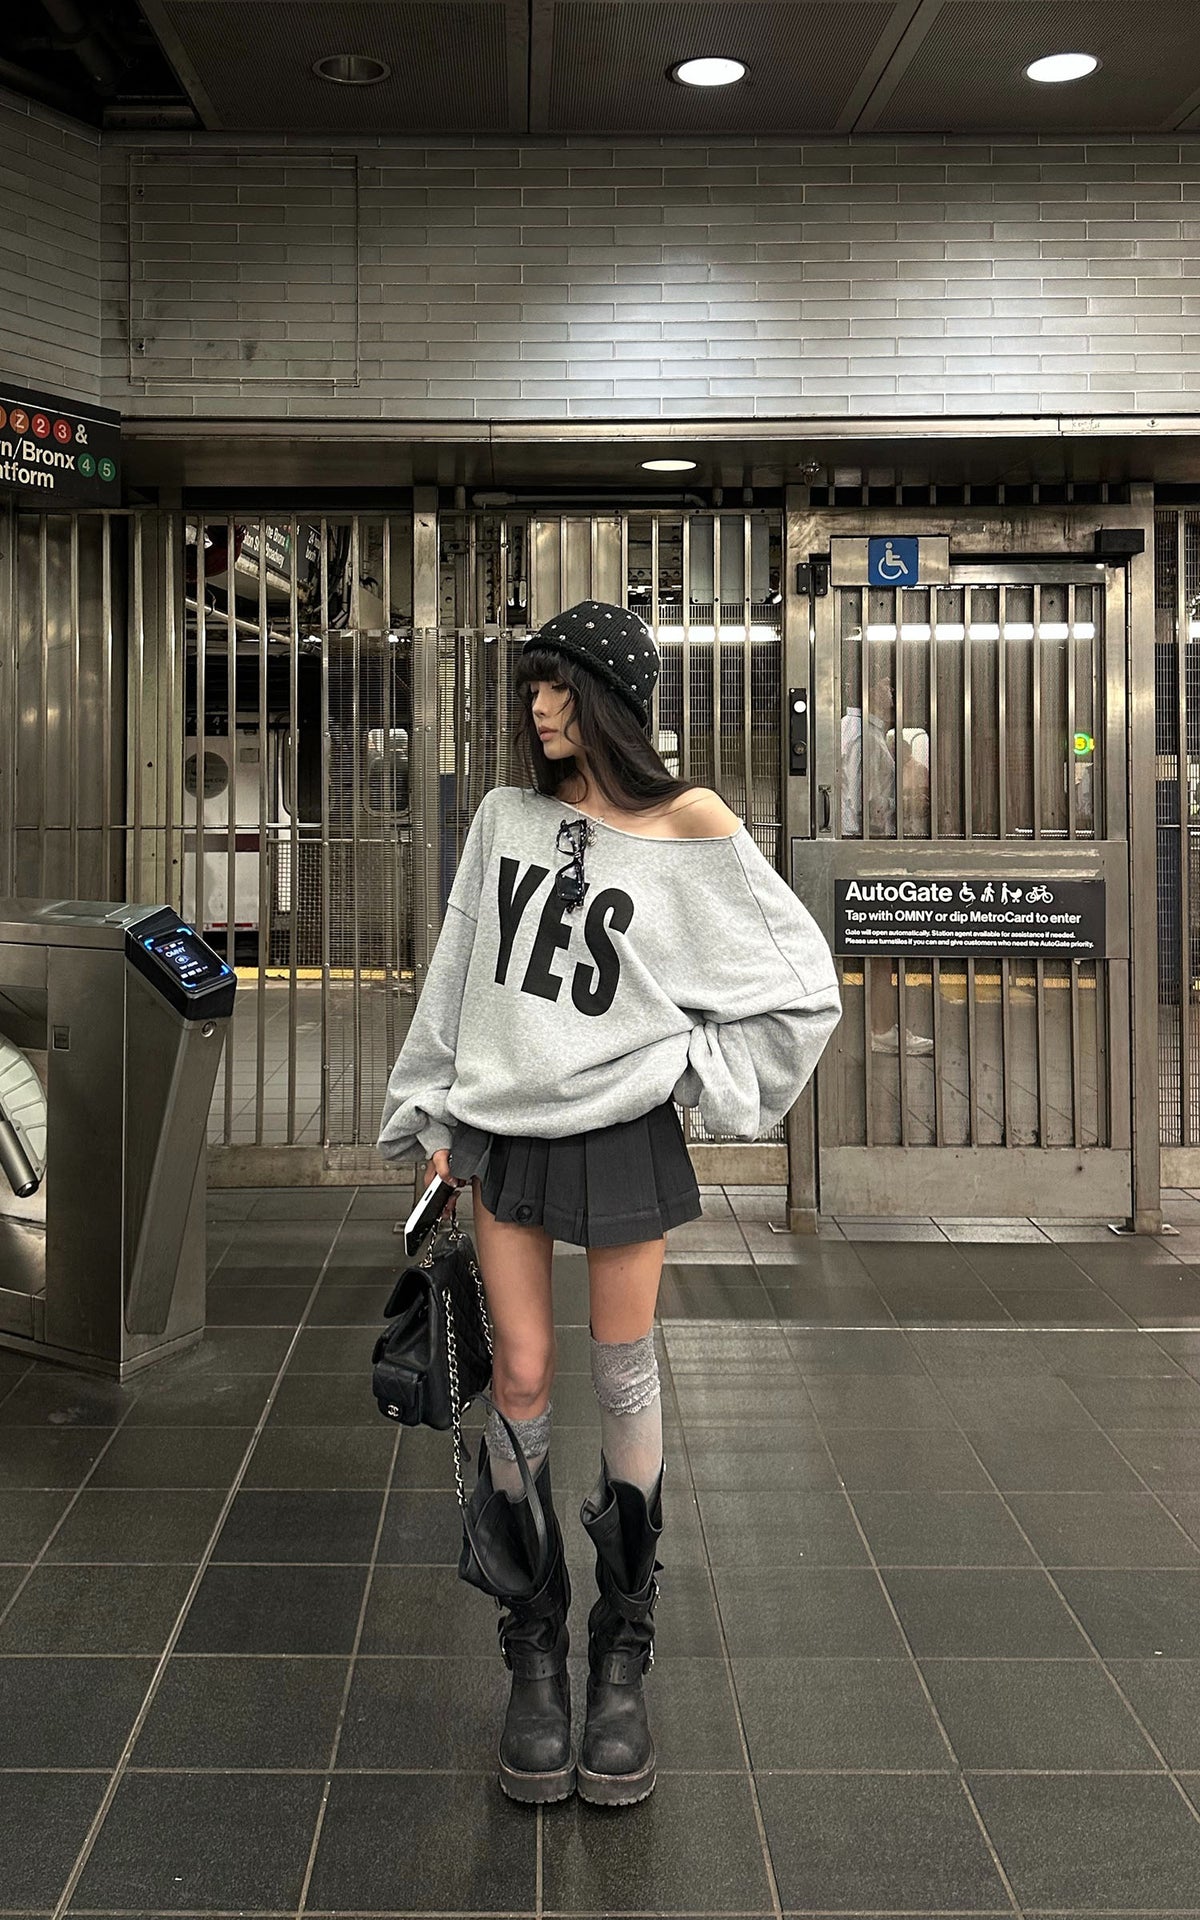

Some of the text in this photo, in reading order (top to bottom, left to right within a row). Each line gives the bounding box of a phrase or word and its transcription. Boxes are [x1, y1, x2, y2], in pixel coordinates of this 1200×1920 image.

[15, 413, 25, 430] Z
[36, 418, 46, 434] 2
[57, 424, 68, 439] 3
[74, 423, 88, 445] &
[81, 458, 91, 473] 4
[102, 462, 112, 478] 5
[845, 881, 953, 903] AutoGate
[845, 909, 1082, 924] Tap with OMNY or dip MetroCard to enter
[494, 856, 635, 1017] YES
[845, 937, 866, 945] Please
[1071, 941, 1094, 949] priority.
[872, 930, 888, 938] open
[931, 929, 955, 937] Station
[973, 930, 1000, 938] available
